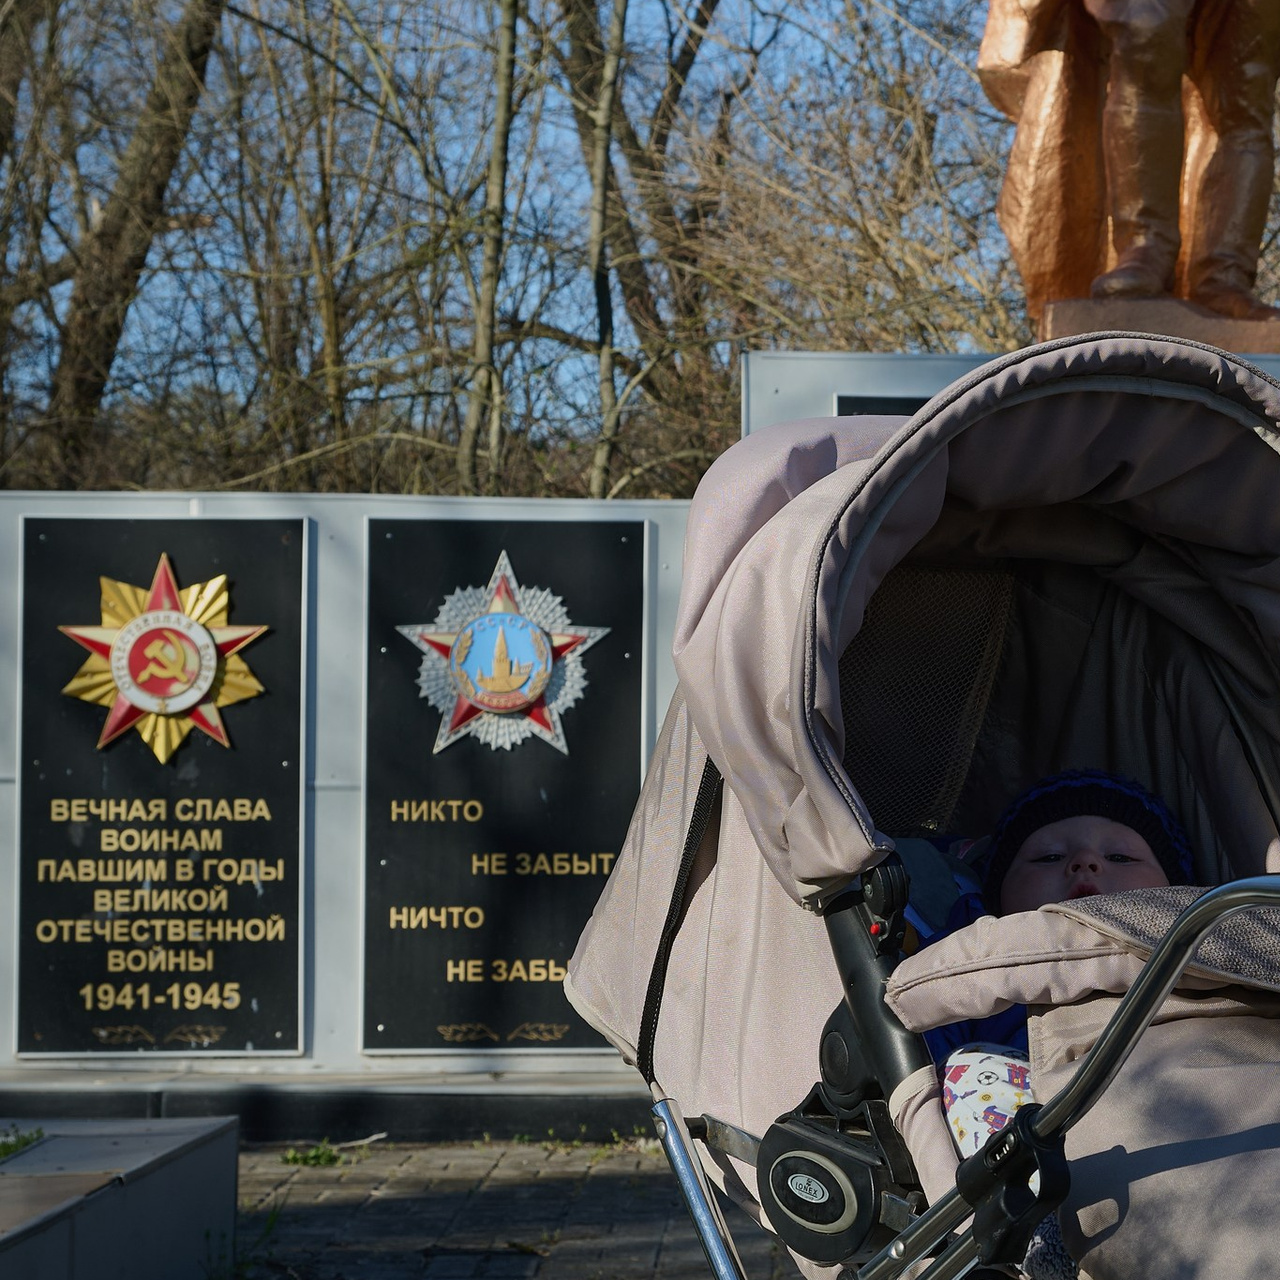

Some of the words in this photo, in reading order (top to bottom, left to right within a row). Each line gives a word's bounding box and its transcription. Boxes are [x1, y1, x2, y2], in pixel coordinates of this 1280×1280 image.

[50, 799, 167, 823] ВЕЧНАЯ
[175, 799, 272, 822] СЛАВА
[390, 800, 483, 823] НИКТО
[101, 829, 222, 852] ВОИНАМ
[37, 859, 167, 884] ПАВШИМ
[176, 859, 196, 882] В
[204, 859, 285, 885] ГОДЫ
[472, 852, 508, 875] НЕ
[515, 852, 615, 875] ЗАБЫТ
[94, 885, 228, 912] ВЕЛИКОЙ
[36, 914, 286, 942] ОТЕЧЕСТВЕННОЙ
[389, 906, 485, 930] НИЧТО
[107, 944, 214, 972] ВОЙНЫ
[446, 959, 485, 982] НЕ
[491, 959, 571, 982] ЗАБЫ
[79, 982, 241, 1011] 1941-1945
